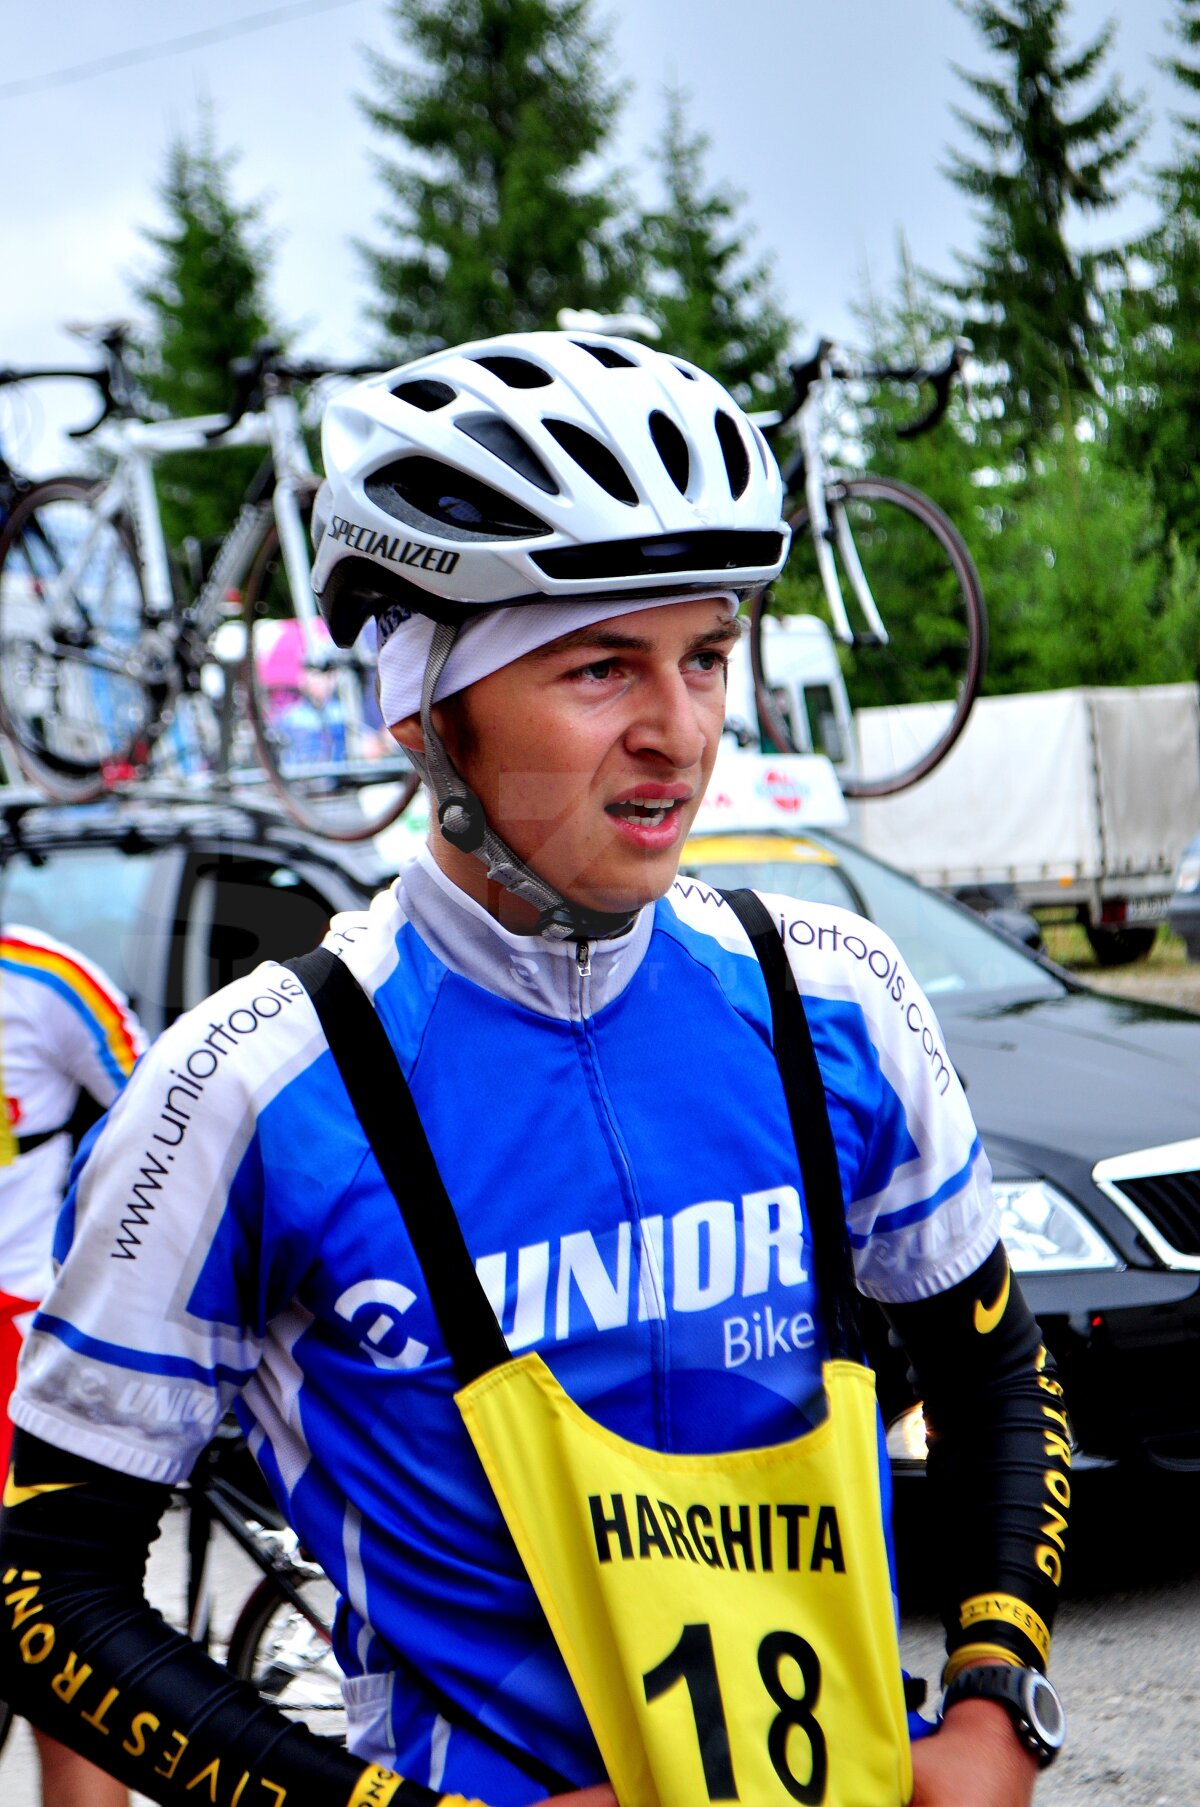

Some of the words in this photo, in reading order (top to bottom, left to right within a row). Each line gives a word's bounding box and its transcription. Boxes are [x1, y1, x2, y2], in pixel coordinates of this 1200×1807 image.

[328, 515, 460, 575] SPECIALIZED
[476, 1185, 808, 1351] UNIOR
[723, 1305, 815, 1368] Bike
[588, 1494, 847, 1574] HARGHITA
[642, 1623, 828, 1806] 18
